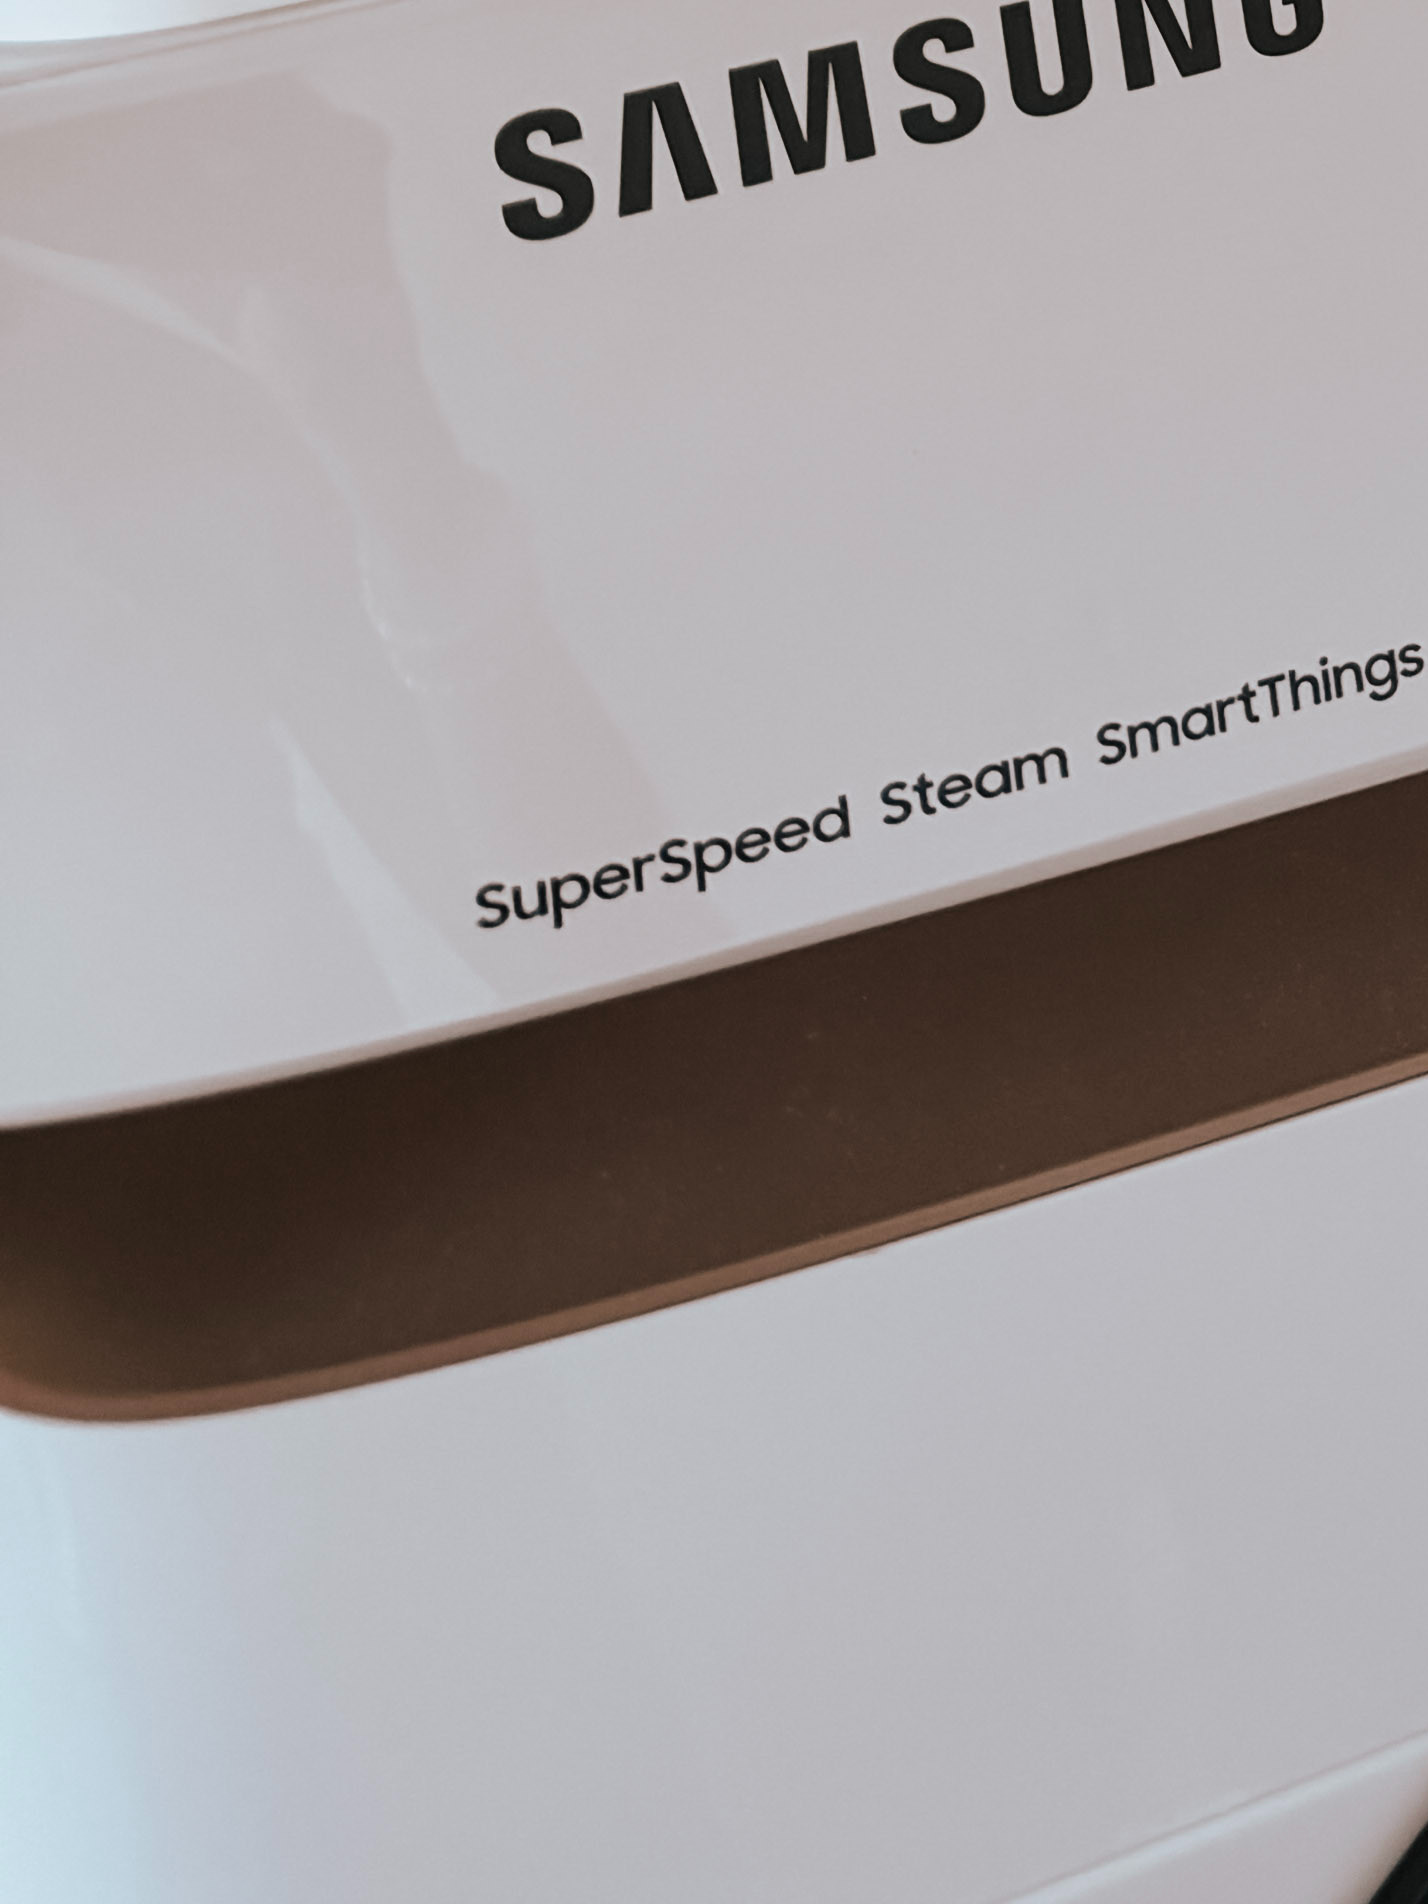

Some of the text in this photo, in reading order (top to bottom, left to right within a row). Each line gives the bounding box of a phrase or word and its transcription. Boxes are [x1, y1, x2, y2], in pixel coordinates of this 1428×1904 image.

[474, 642, 1425, 930] SuperSpeed Steam SmartThings
